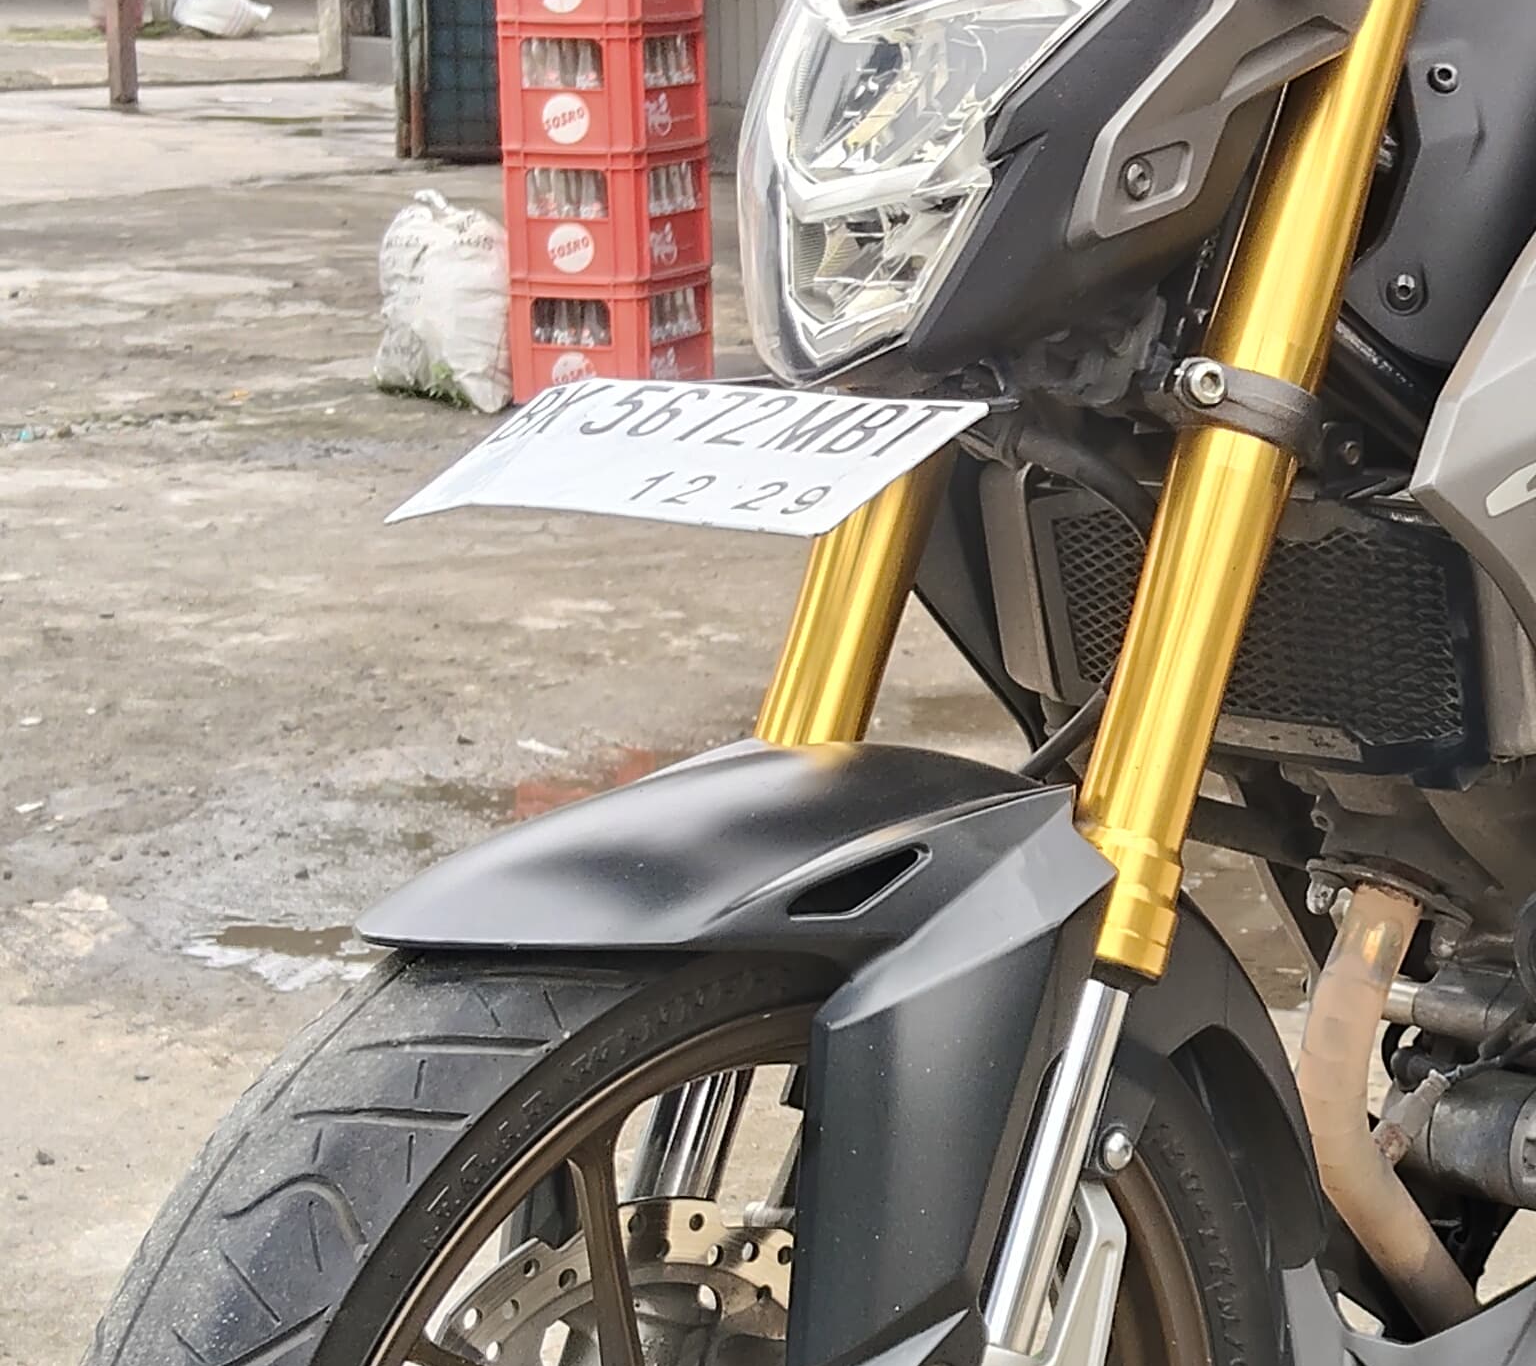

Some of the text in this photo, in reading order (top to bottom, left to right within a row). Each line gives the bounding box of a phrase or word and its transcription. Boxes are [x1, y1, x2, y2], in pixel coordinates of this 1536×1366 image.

[543, 106, 585, 131] SOSRO
[549, 235, 590, 262] SOSRO
[489, 384, 961, 459] BK 5672 MBT
[628, 471, 833, 515] 12 29
